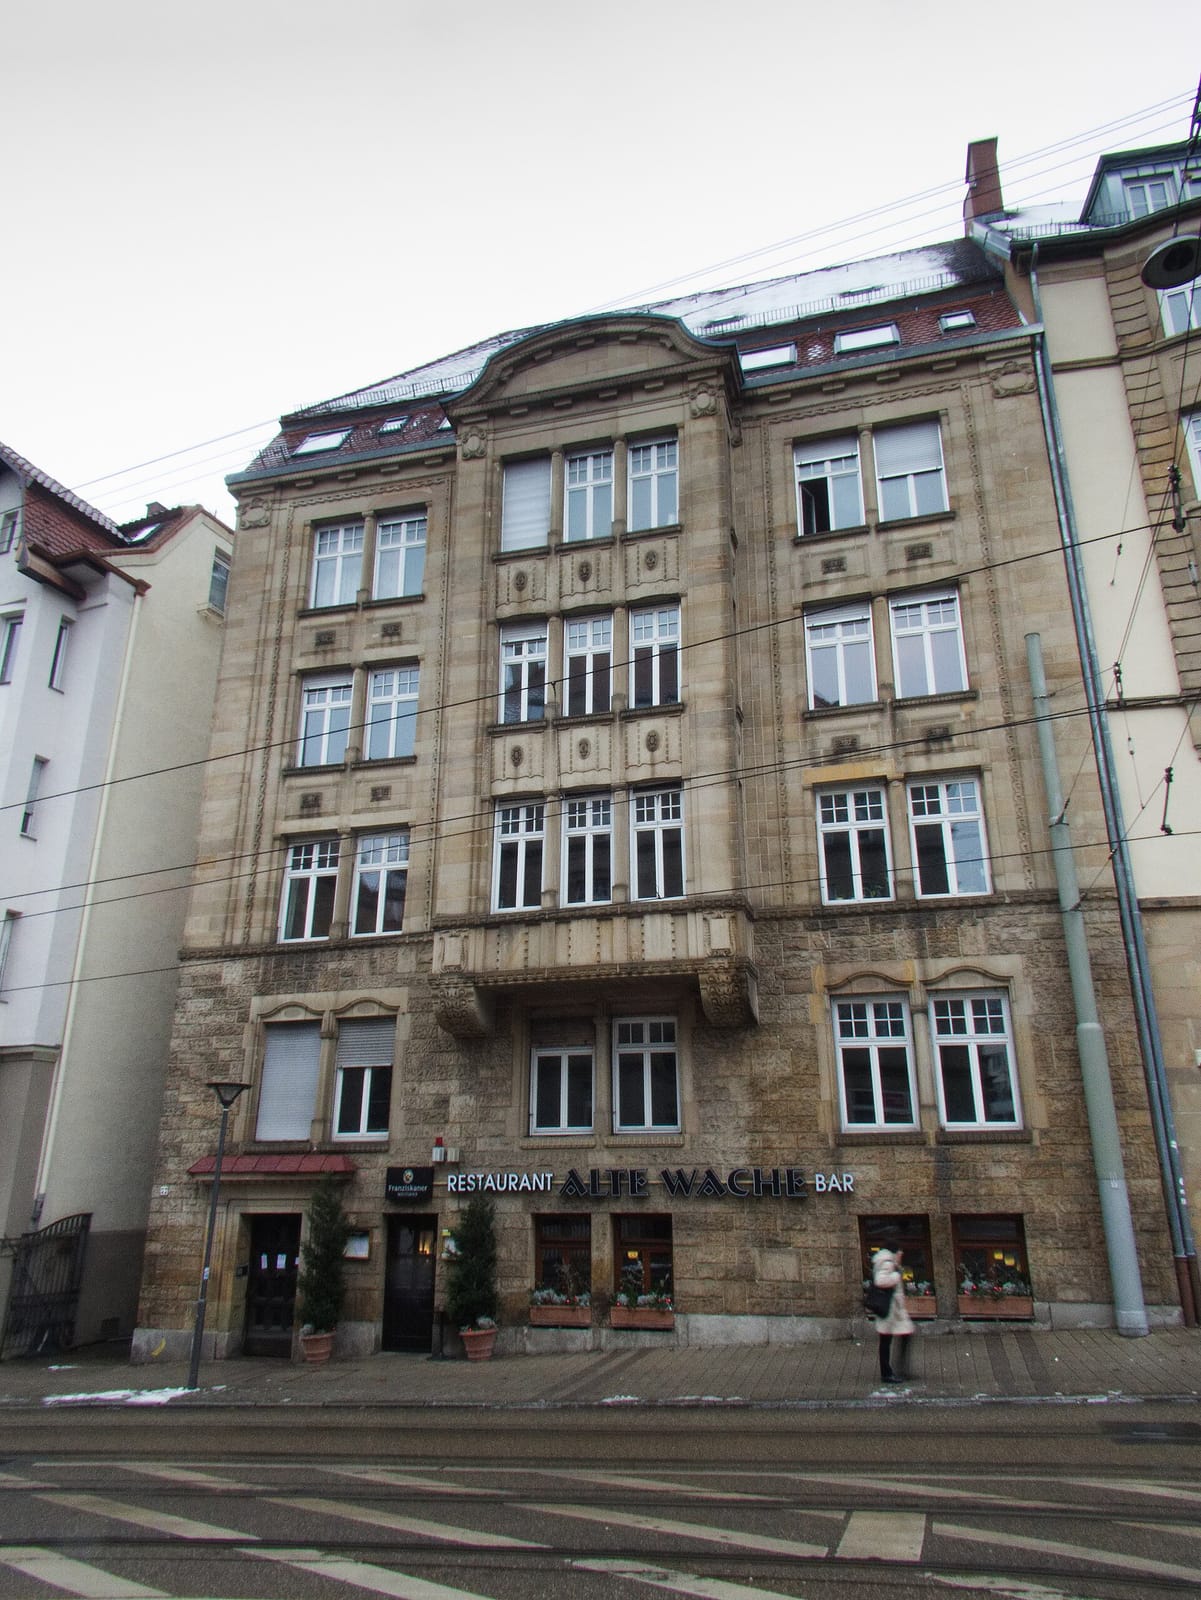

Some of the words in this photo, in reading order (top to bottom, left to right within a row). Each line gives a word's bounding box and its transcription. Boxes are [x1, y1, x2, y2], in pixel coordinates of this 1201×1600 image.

[447, 1173, 553, 1192] RESTAURANT
[559, 1168, 648, 1197] ALTE
[660, 1168, 808, 1197] WACHE
[815, 1173, 854, 1192] BAR
